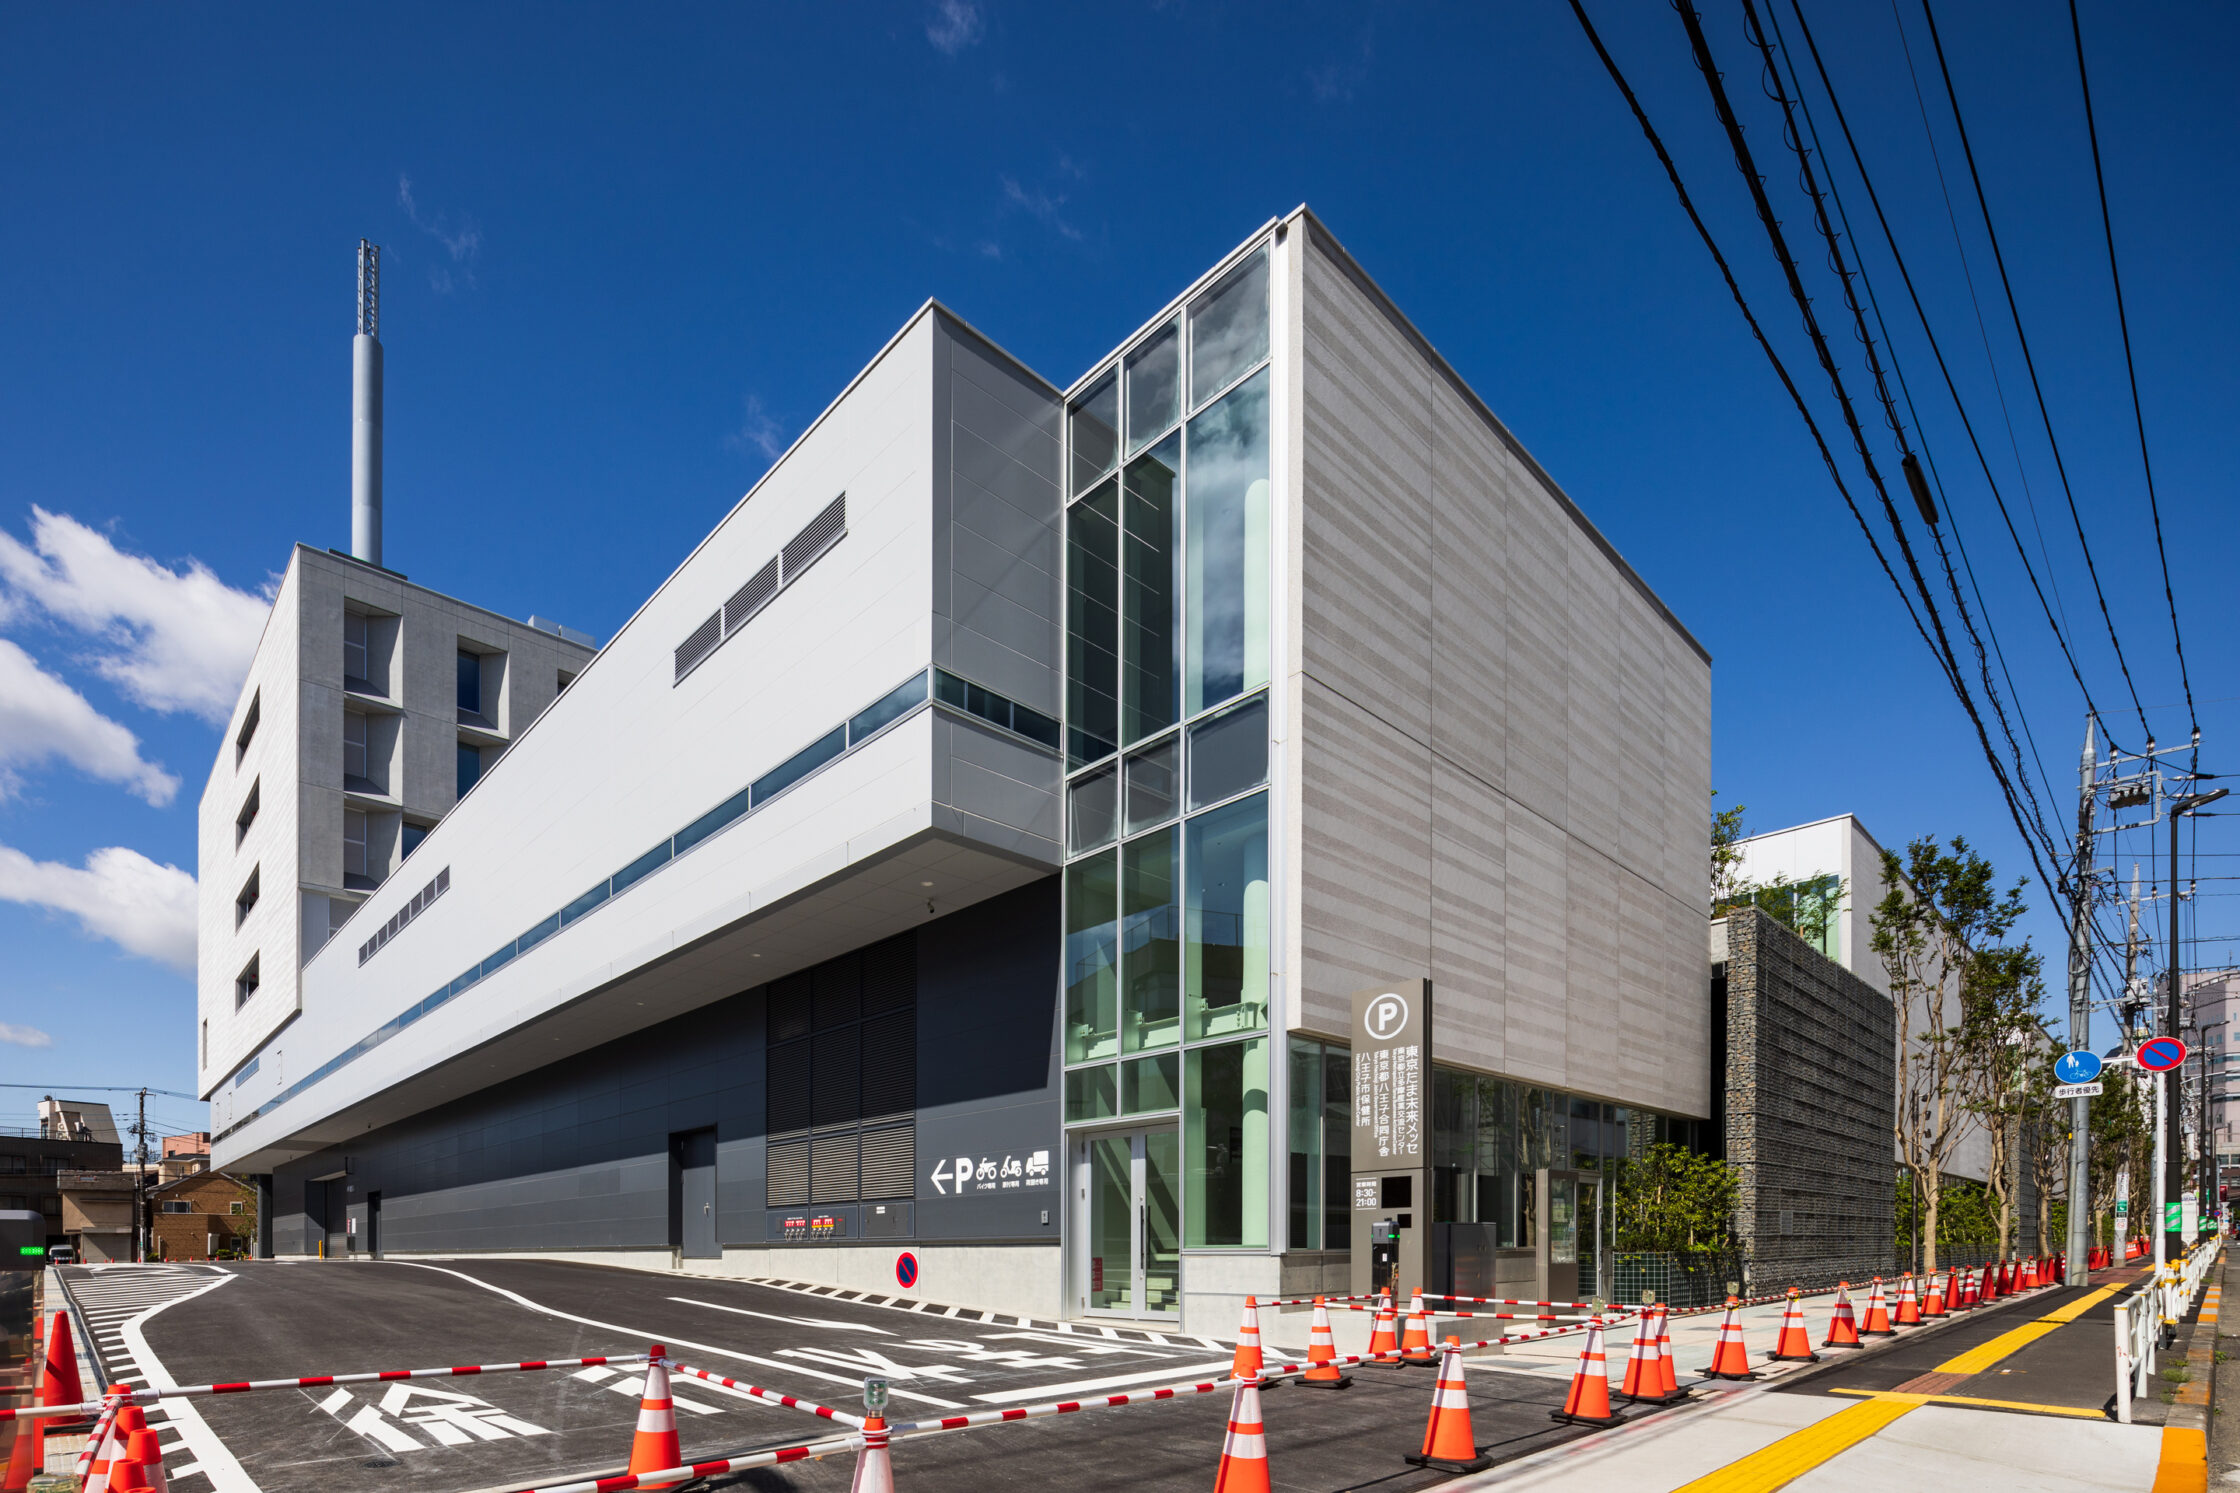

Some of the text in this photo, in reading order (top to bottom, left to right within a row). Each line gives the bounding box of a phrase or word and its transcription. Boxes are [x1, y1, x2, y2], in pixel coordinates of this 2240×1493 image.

[1378, 1002, 1398, 1032] P
[1361, 1052, 1371, 1127] 八王子市保健所
[1378, 1049, 1390, 1157] 東京都八王子合同庁舎
[1405, 1045, 1419, 1155] 東京たま未来メッセ
[2058, 1085, 2100, 1097] 歩行者優先
[955, 1157, 974, 1194] P
[1355, 1197, 1377, 1207] 21:00
